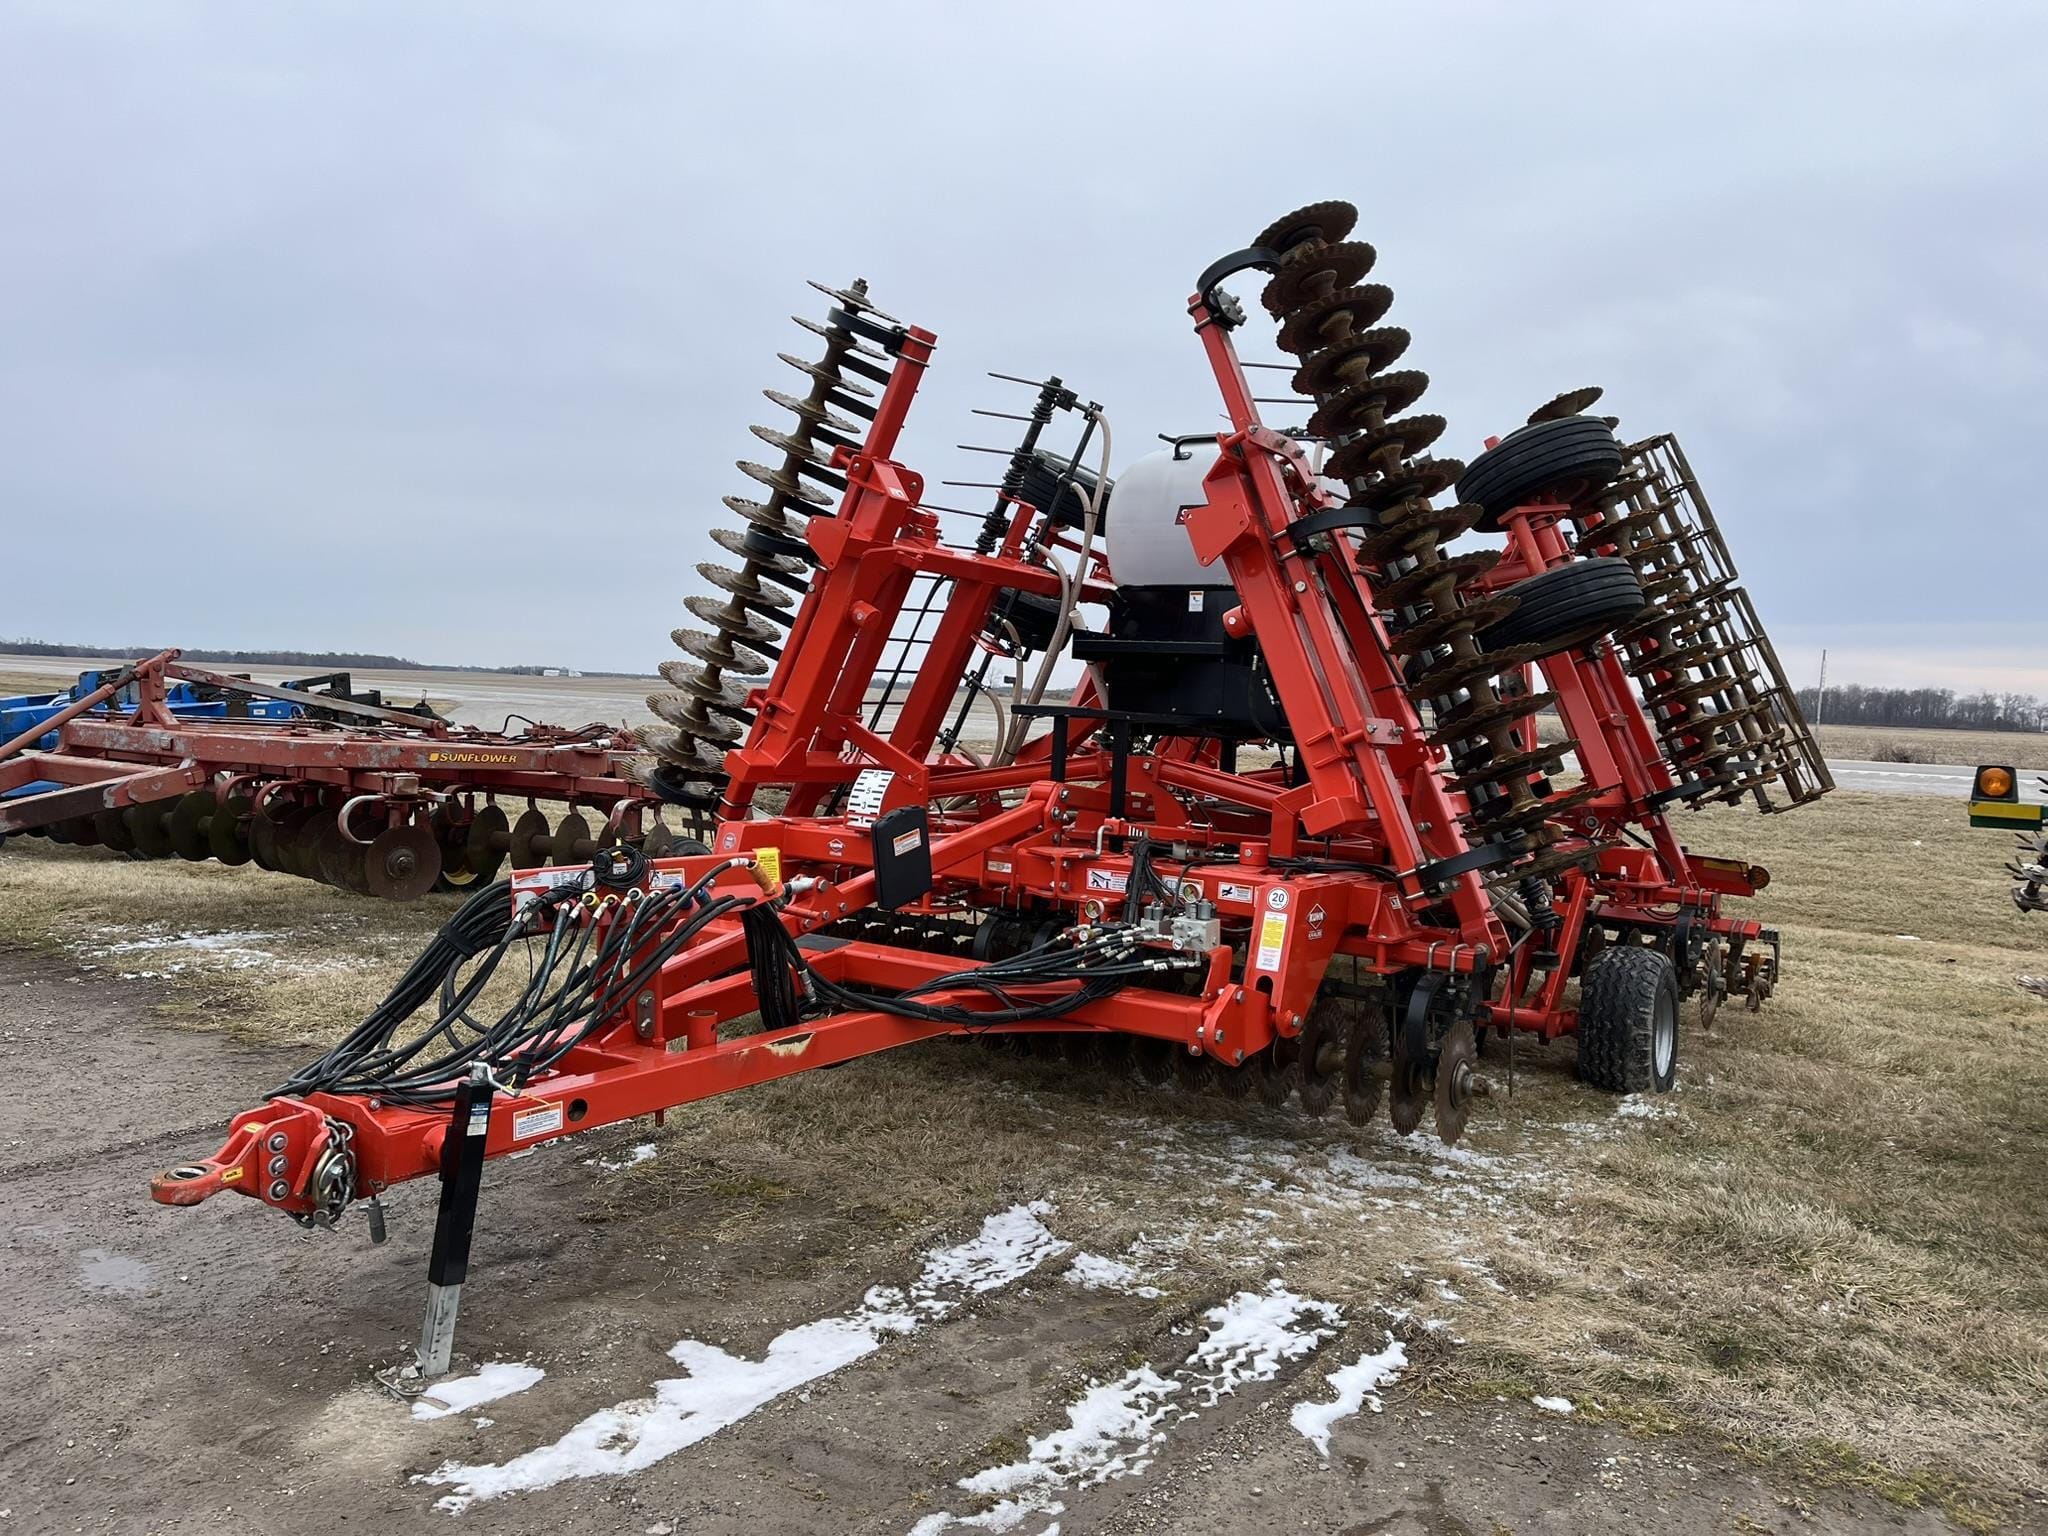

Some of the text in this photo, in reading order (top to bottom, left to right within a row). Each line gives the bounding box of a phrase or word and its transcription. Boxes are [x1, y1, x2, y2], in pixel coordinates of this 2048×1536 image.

[440, 752, 517, 763] SUNFLOWER
[865, 787, 872, 795] 5
[861, 801, 867, 810] 3
[1271, 892, 1285, 903] 20
